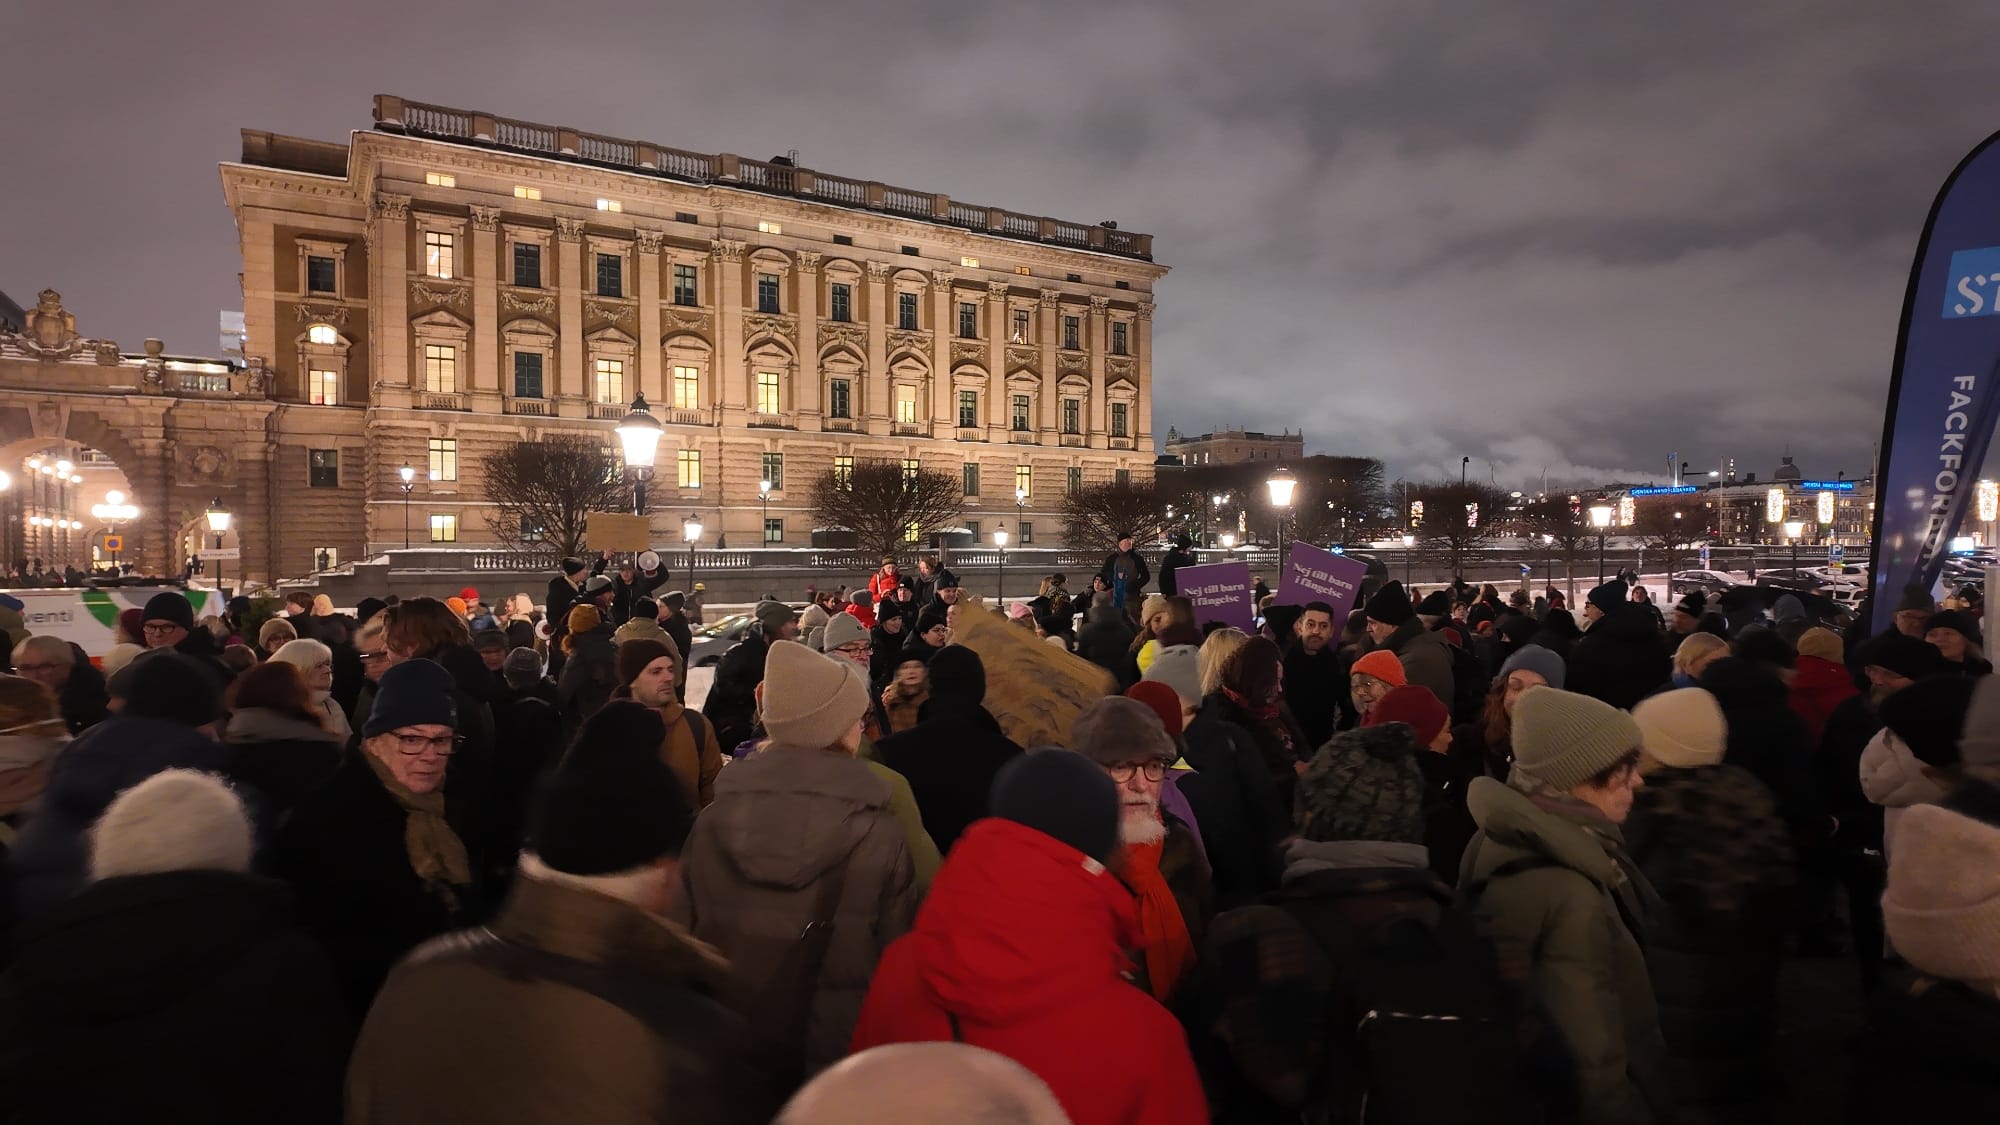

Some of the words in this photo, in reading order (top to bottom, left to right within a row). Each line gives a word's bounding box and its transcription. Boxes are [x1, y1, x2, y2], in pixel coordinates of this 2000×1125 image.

[1832, 545, 1842, 555] P
[1293, 563, 1312, 577] Nej
[1311, 570, 1329, 581] till
[1328, 575, 1353, 590] barn
[1184, 586, 1202, 597] Nej
[1204, 584, 1219, 594] till
[1220, 583, 1245, 592] barn
[1191, 598, 1196, 606] i
